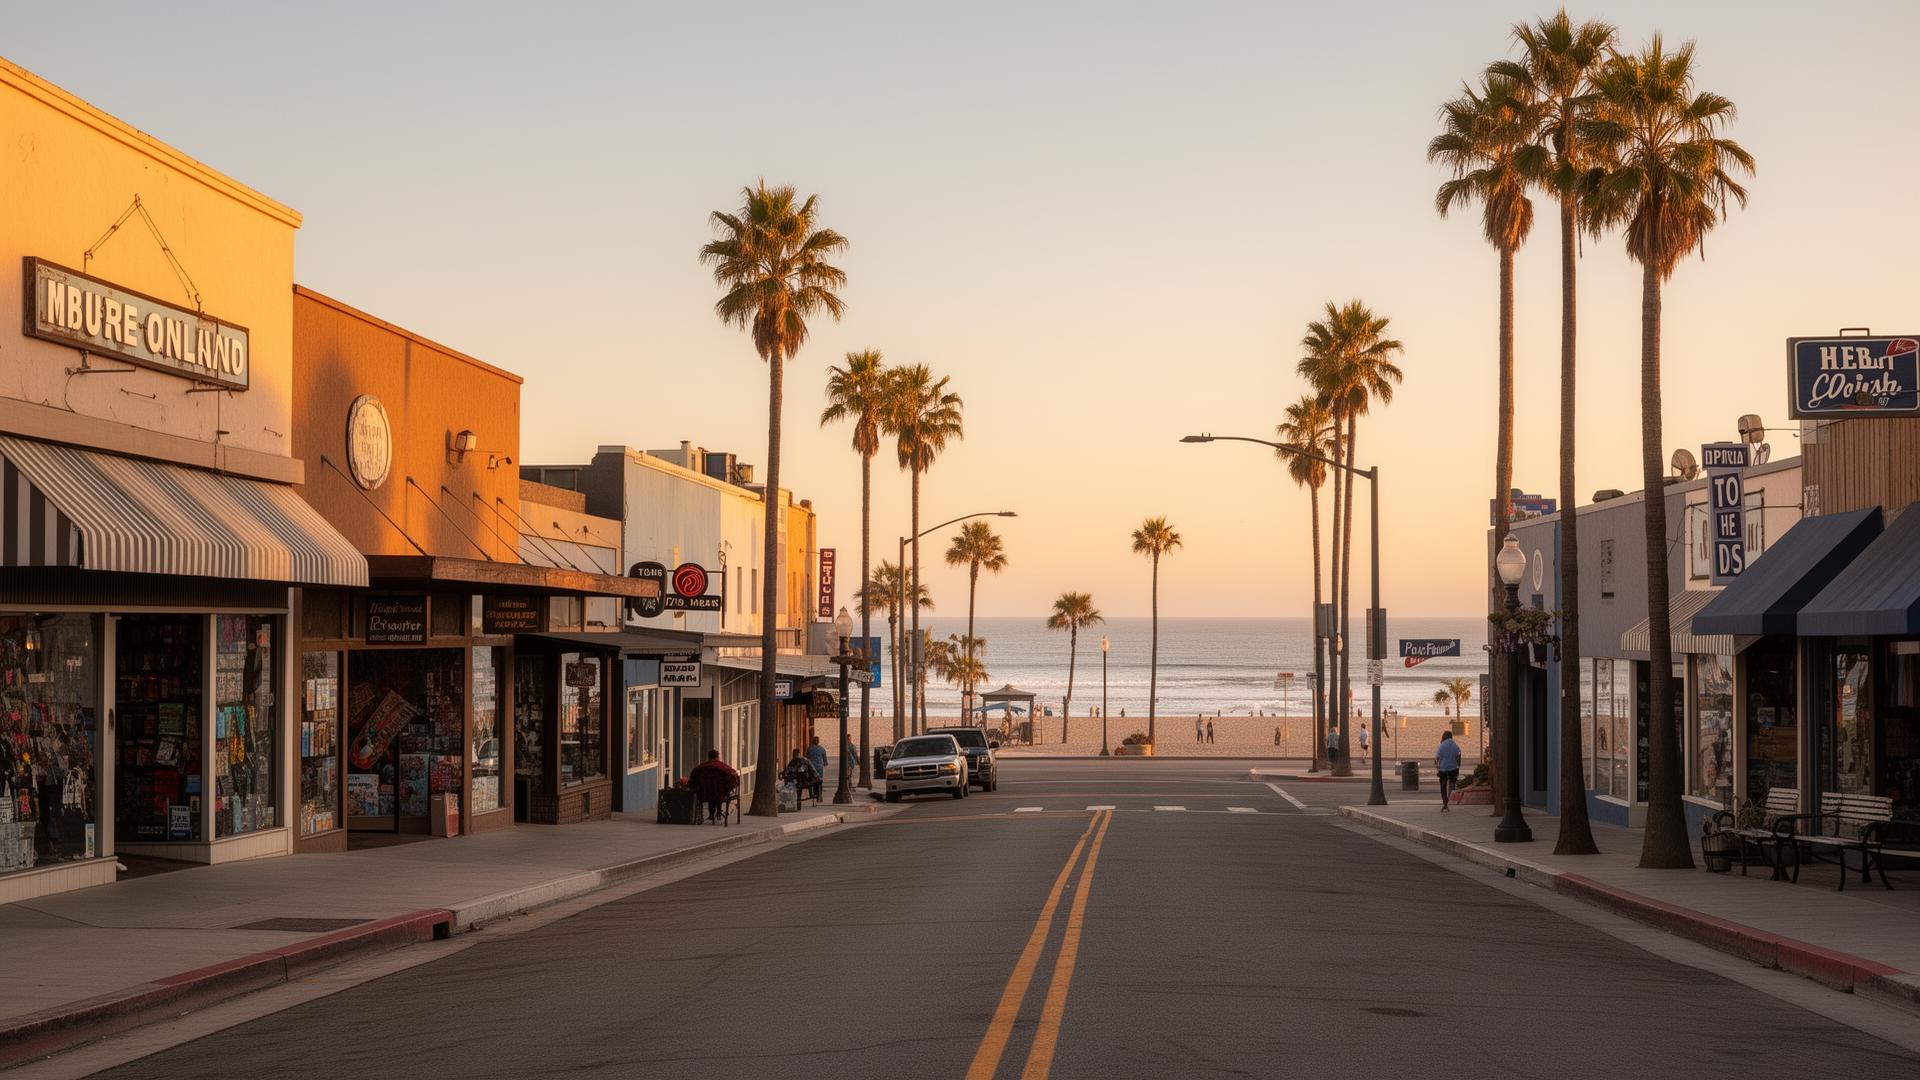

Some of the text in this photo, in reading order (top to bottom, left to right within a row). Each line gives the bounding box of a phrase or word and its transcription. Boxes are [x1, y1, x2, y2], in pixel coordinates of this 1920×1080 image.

[47, 279, 138, 347] MBURE
[1714, 476, 1739, 508] TO
[1720, 513, 1736, 536] HE
[1718, 543, 1743, 575] DS
